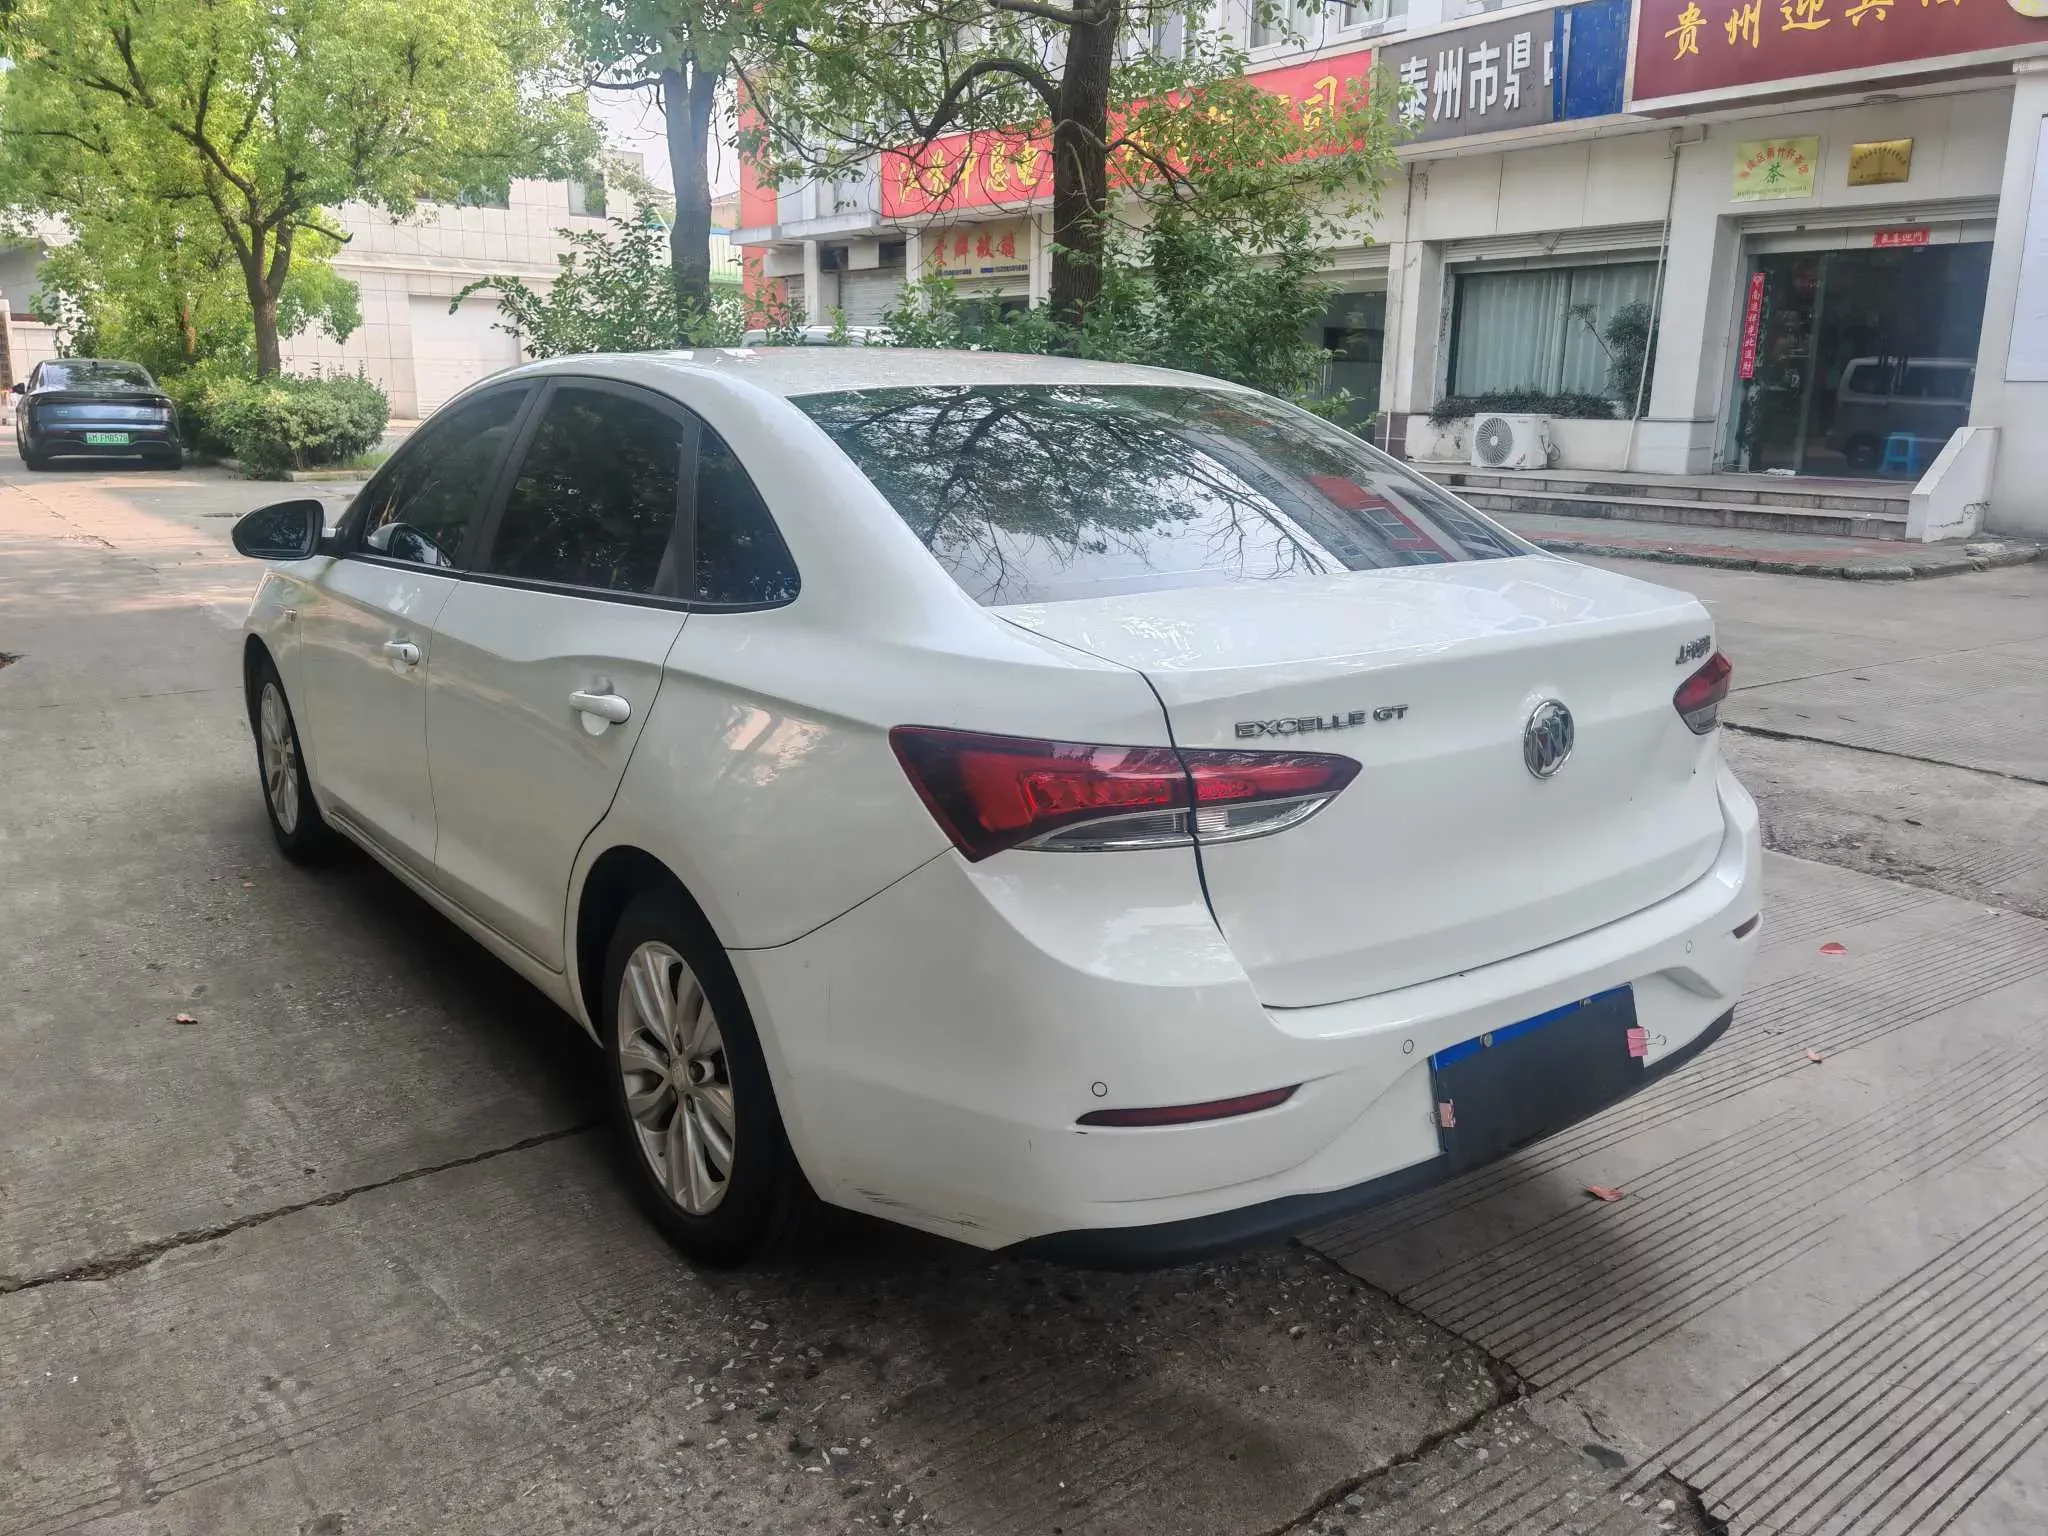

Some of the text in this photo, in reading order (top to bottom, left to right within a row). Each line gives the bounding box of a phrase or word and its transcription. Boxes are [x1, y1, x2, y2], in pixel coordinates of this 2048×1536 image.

[1664, 0, 1960, 61] 贵州迎
[1398, 31, 1553, 122] 泰州市鼎
[1234, 704, 1409, 738] EXCELLE GT
